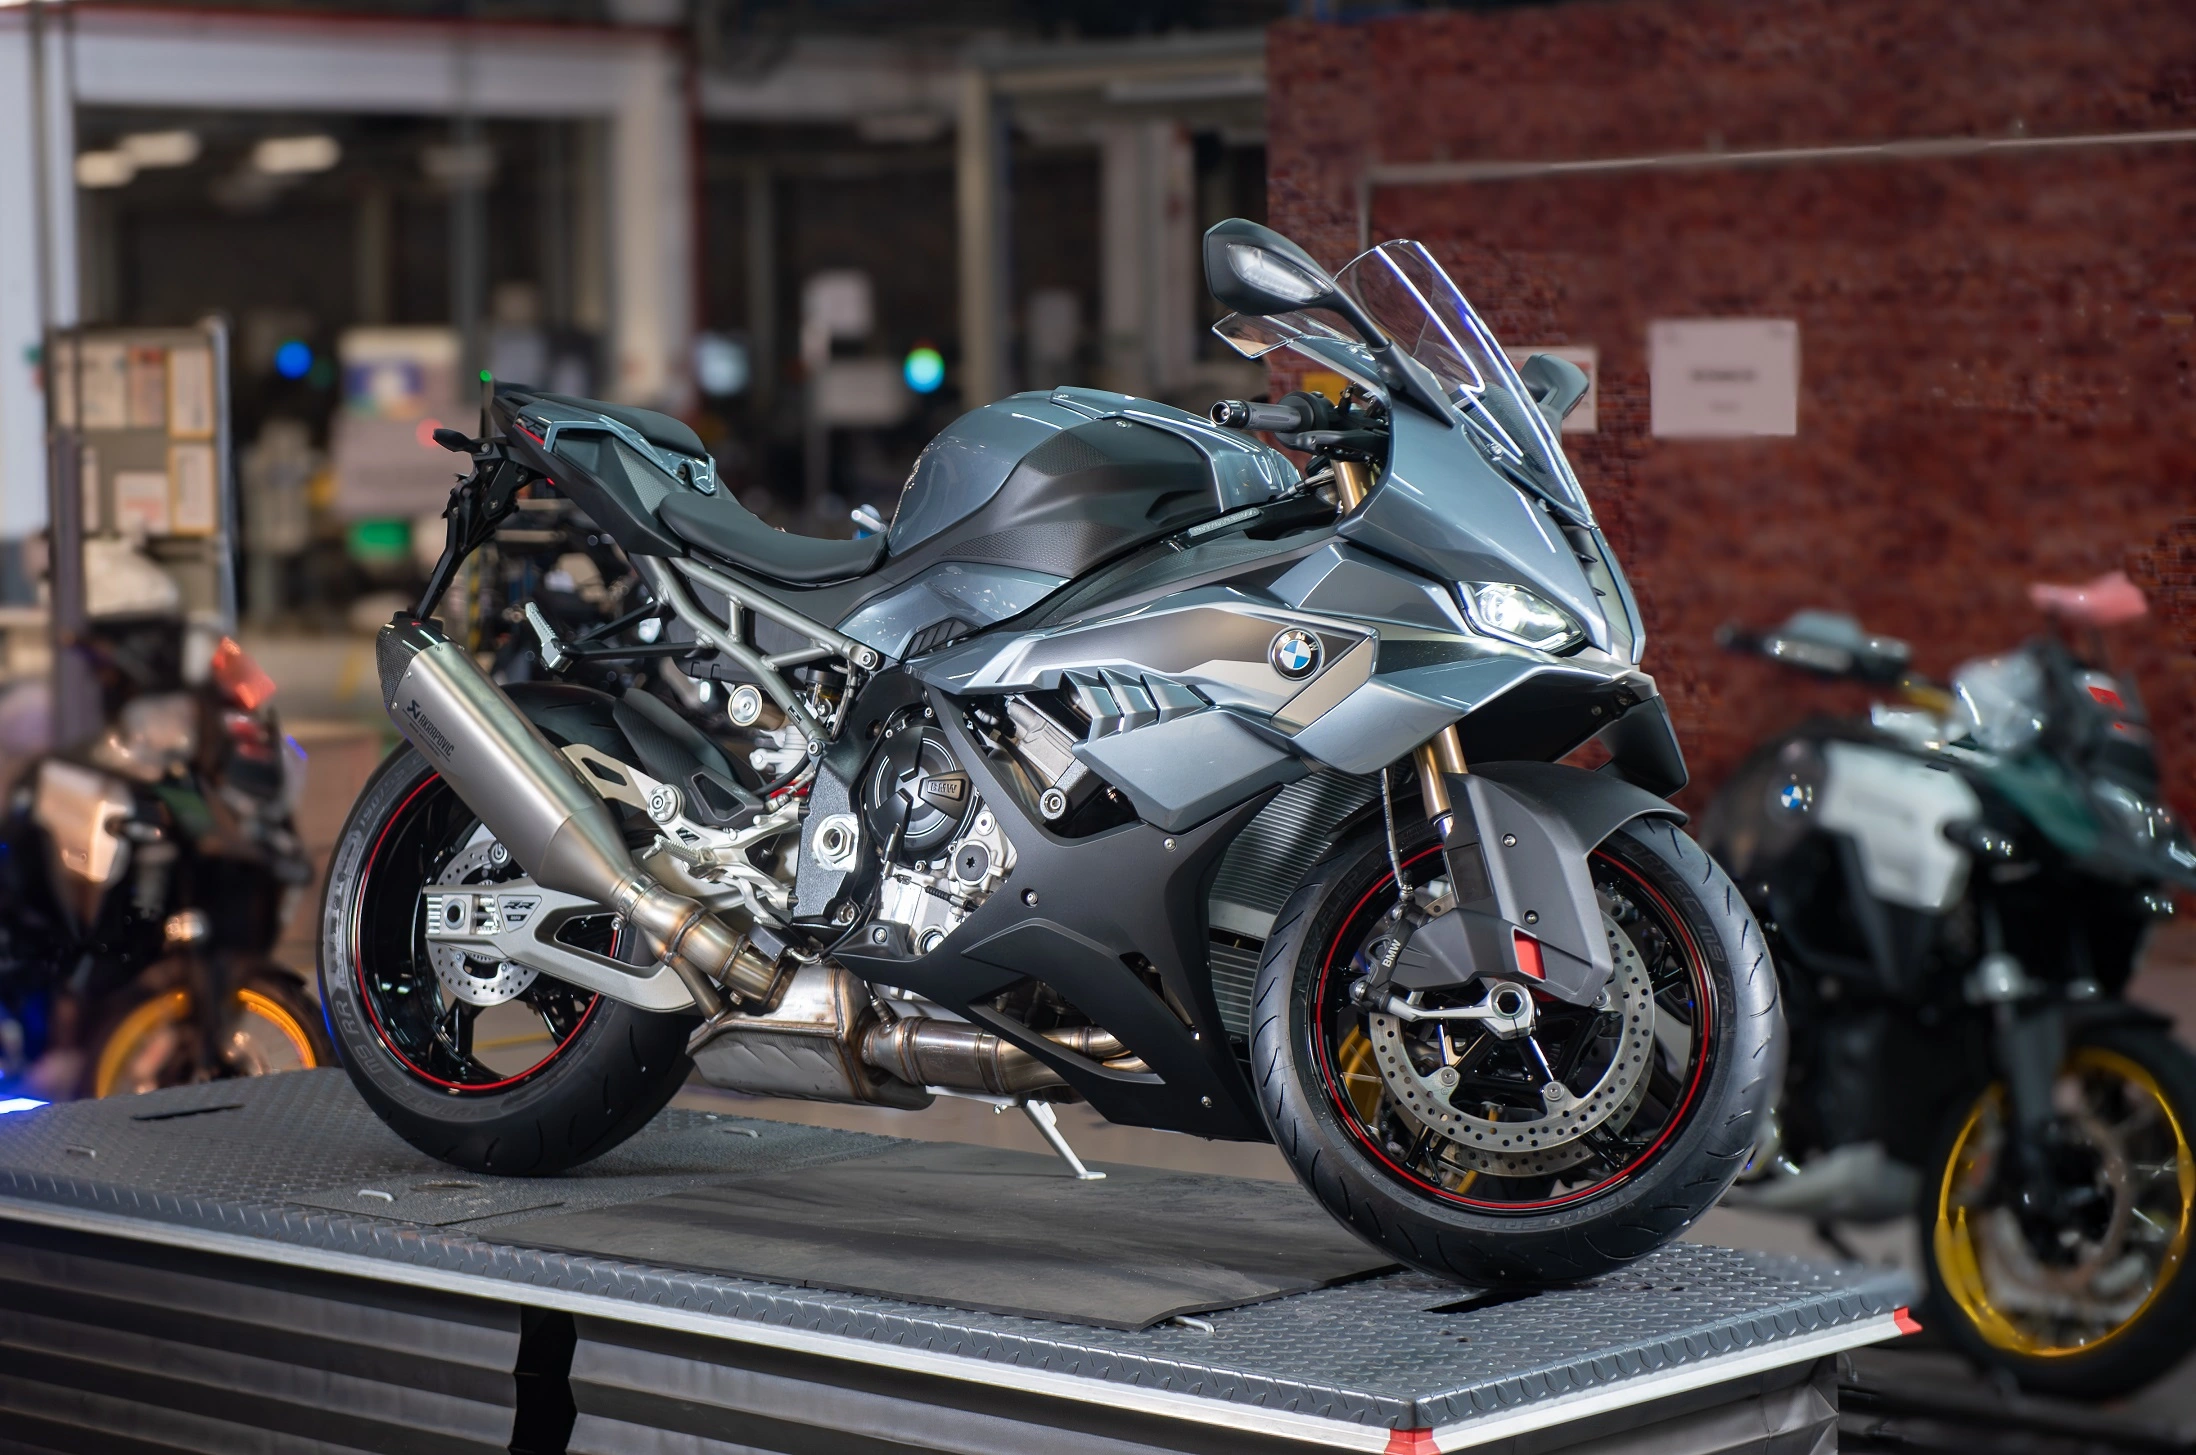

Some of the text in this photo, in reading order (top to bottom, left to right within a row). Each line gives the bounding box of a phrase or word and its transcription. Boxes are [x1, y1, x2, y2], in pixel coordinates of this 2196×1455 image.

[1279, 631, 1319, 652] BMW
[418, 714, 454, 757] AKRAPOVIC
[930, 781, 958, 794] BMW
[503, 899, 536, 910] RR
[1292, 869, 1364, 991] METZELER
[1382, 938, 1401, 967] BMW
[334, 995, 359, 1040] RR
